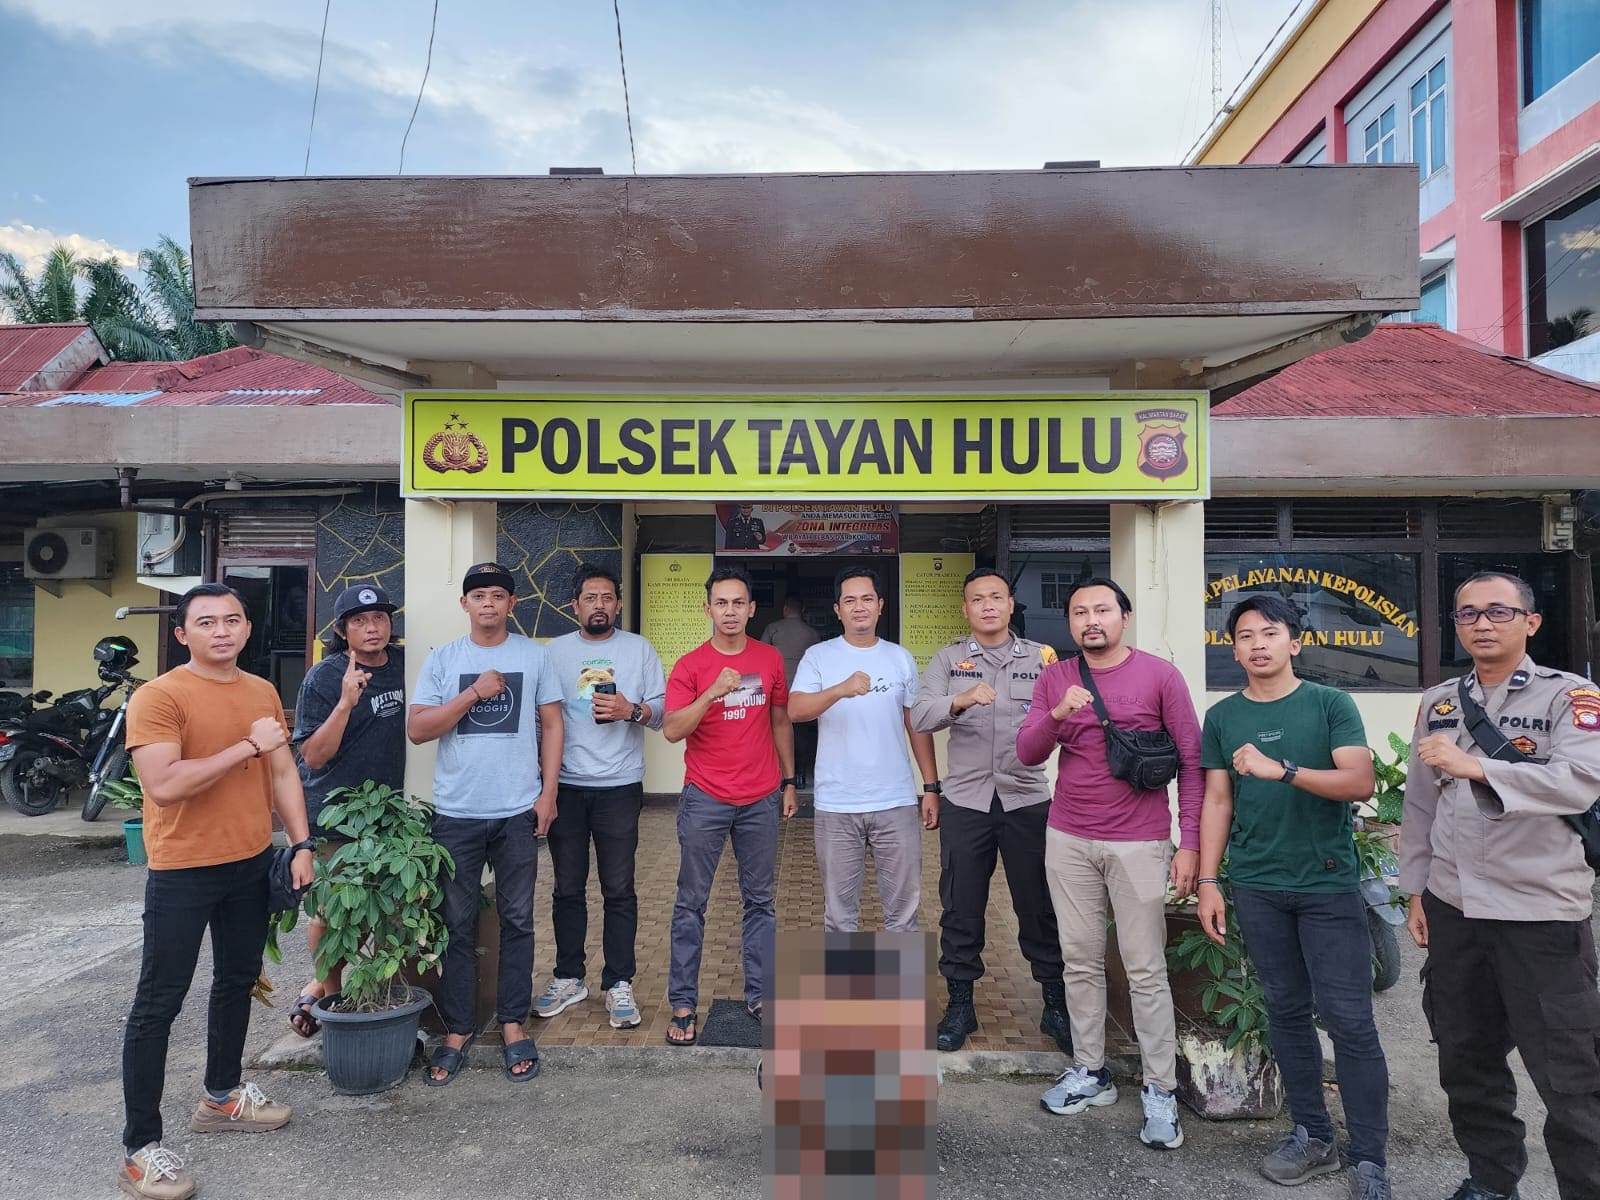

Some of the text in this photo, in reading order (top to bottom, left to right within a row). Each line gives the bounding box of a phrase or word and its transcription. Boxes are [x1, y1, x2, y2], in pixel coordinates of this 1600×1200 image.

[1169, 411, 1186, 419] BARAT
[501, 416, 1122, 475] POLSEK TAYAN HULU
[861, 503, 893, 512] HULU
[796, 521, 890, 531] ZONA INTEGRITAS
[1209, 567, 1420, 639] PELAYANAN KEPOLISIAN
[1334, 630, 1384, 646] HULU
[722, 708, 746, 721] 1990
[1499, 715, 1553, 732] POLRI
